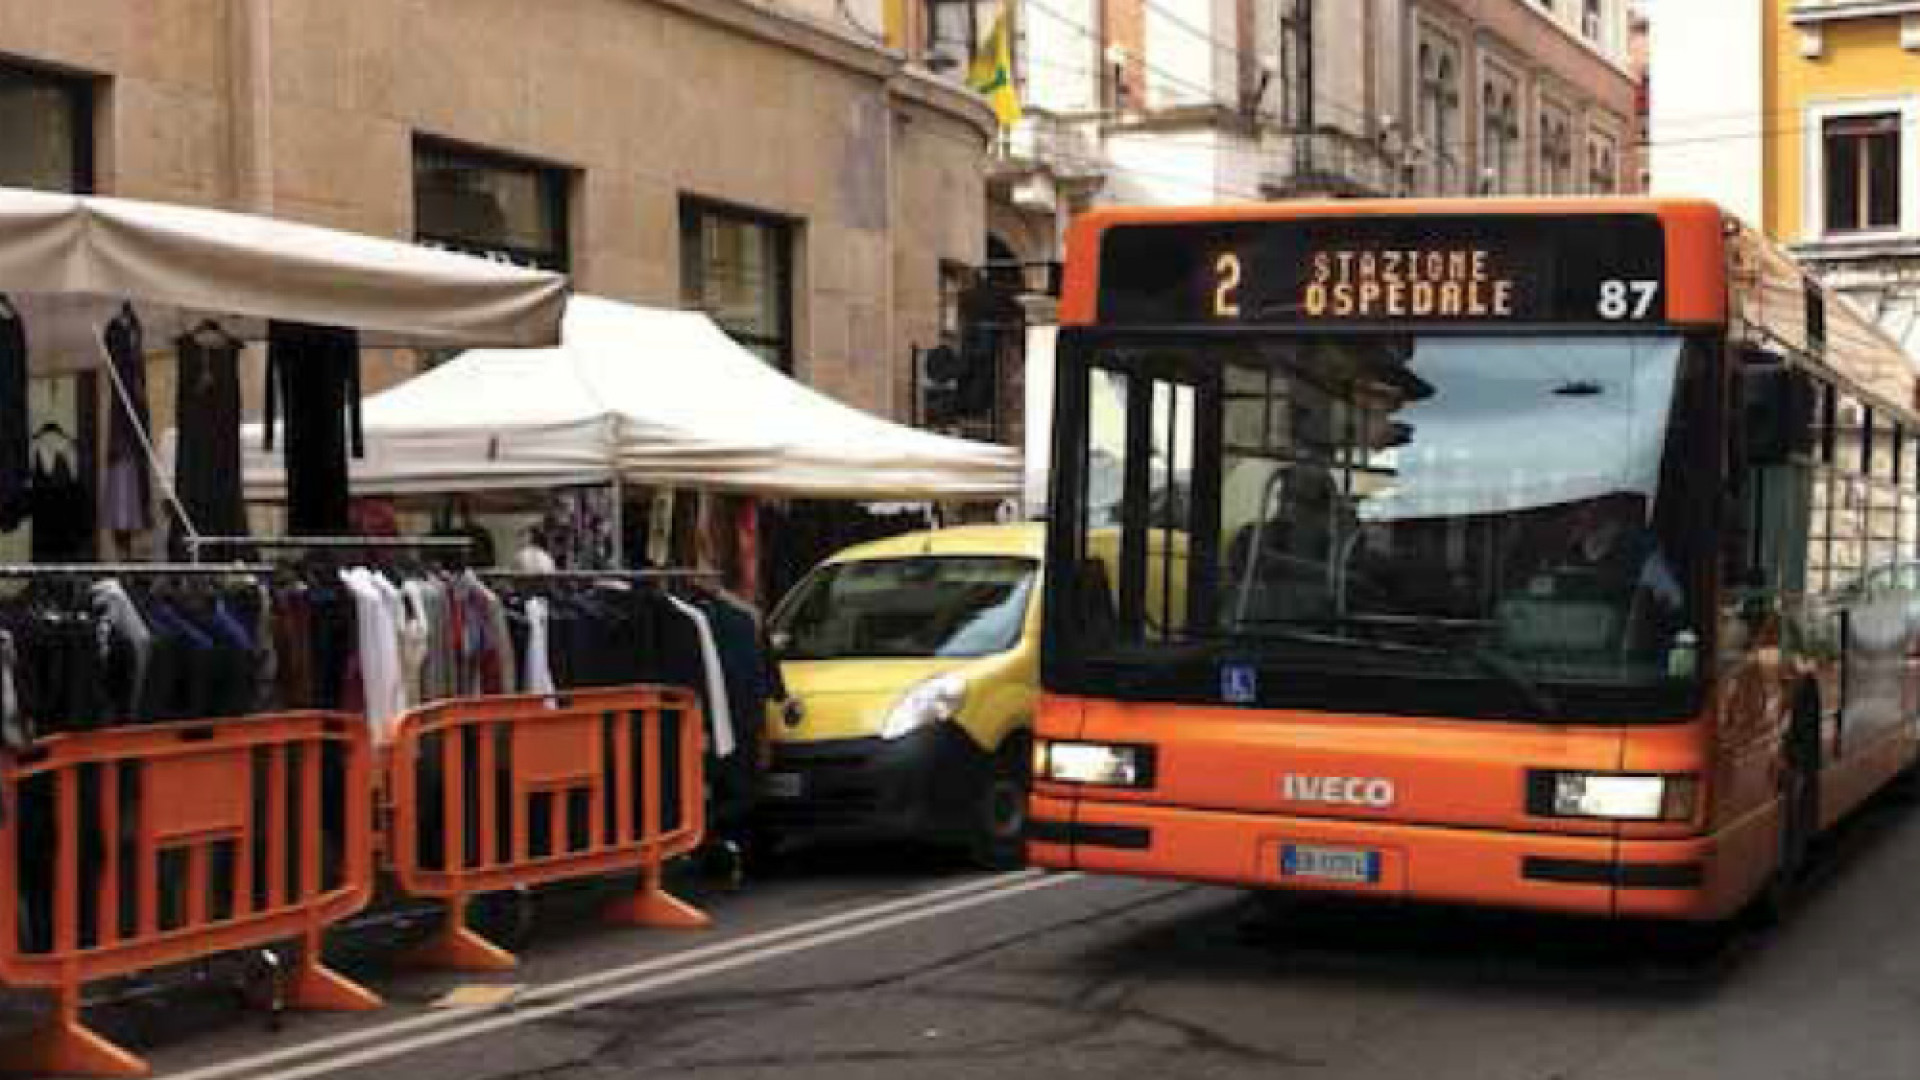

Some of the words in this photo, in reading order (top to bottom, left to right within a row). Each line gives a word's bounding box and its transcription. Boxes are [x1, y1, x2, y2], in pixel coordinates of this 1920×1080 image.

[1313, 250, 1489, 282] STAZIONE
[1214, 252, 1241, 316] 2
[1305, 281, 1513, 316] OSPEDALE
[1597, 279, 1659, 318] 87
[1282, 772, 1396, 805] IVECO
